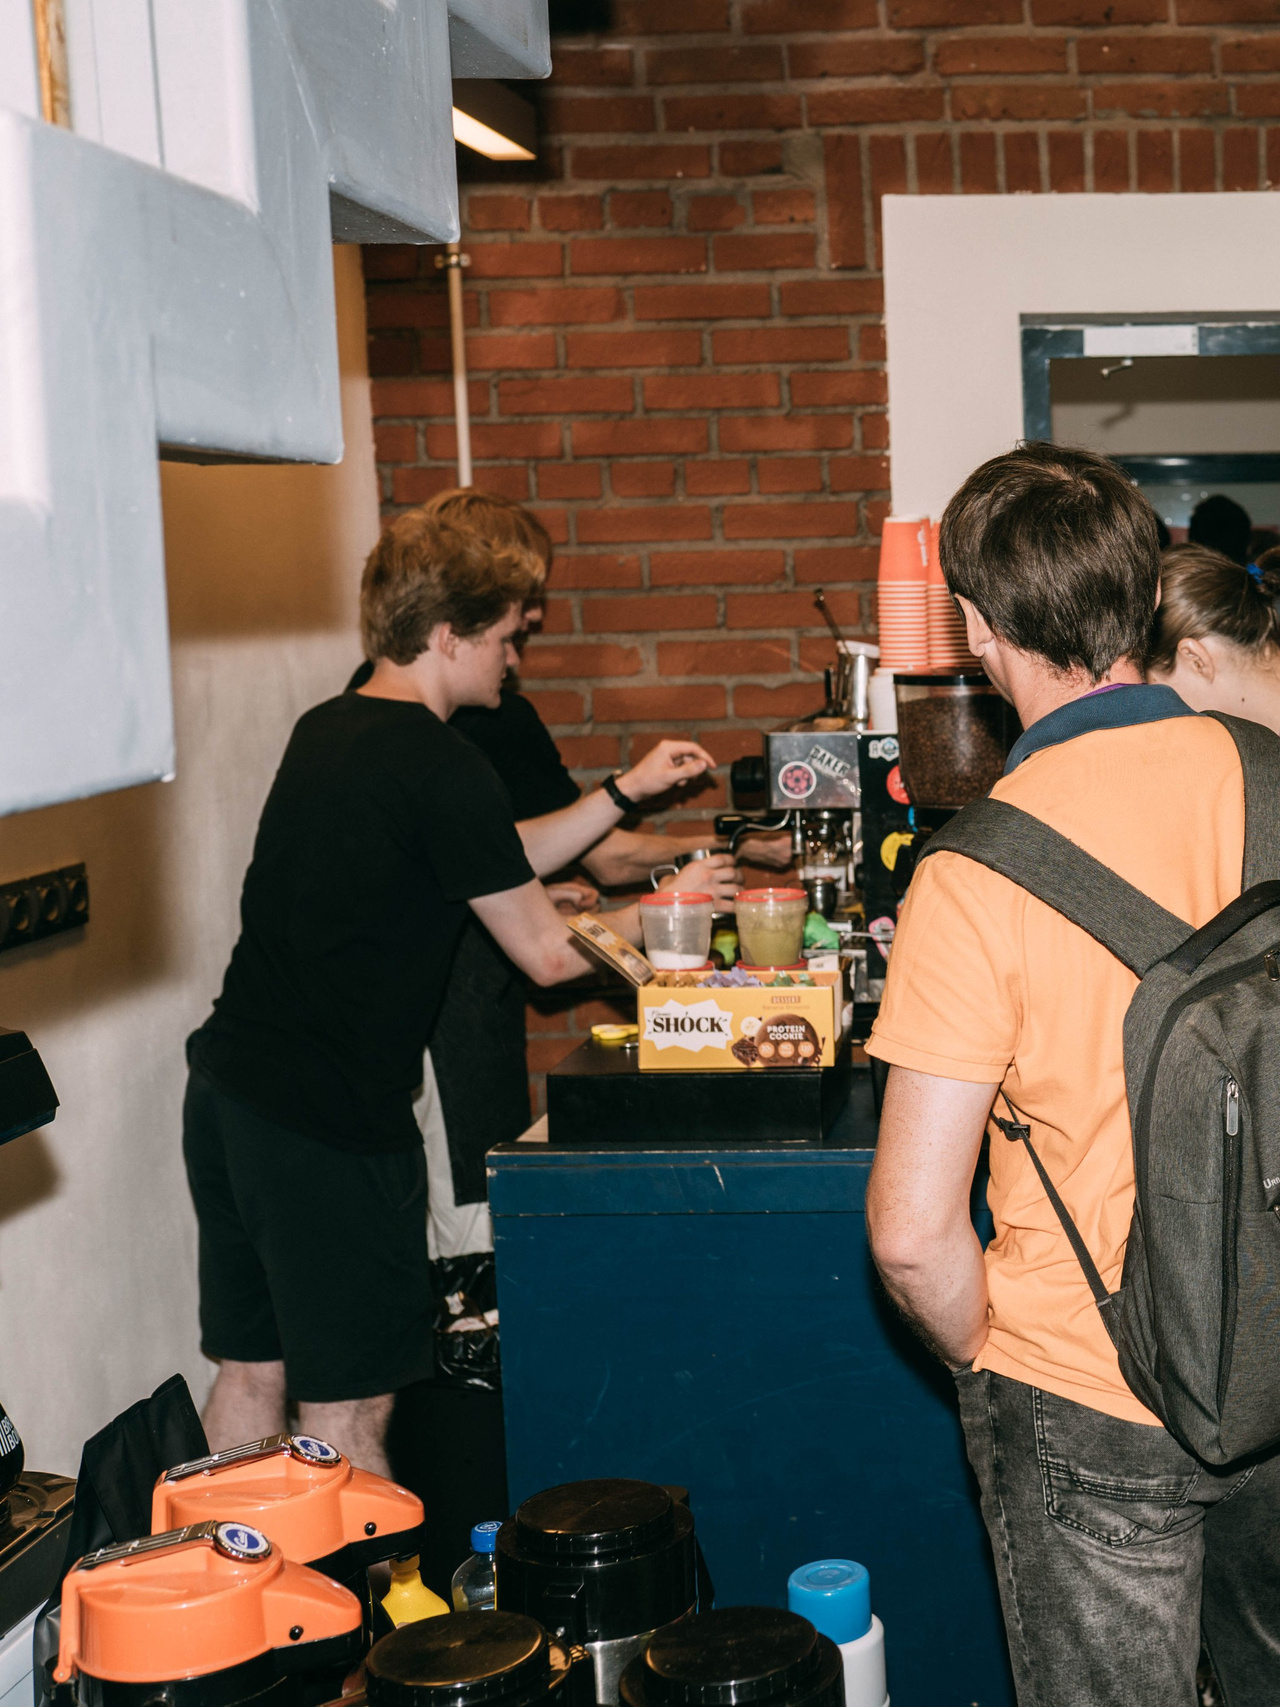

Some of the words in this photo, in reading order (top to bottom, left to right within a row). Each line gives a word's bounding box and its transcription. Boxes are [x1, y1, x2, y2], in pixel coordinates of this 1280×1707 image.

[653, 1016, 723, 1033] SHOCK
[766, 1025, 806, 1033] PROTEIN
[769, 1032, 804, 1040] COOKIE
